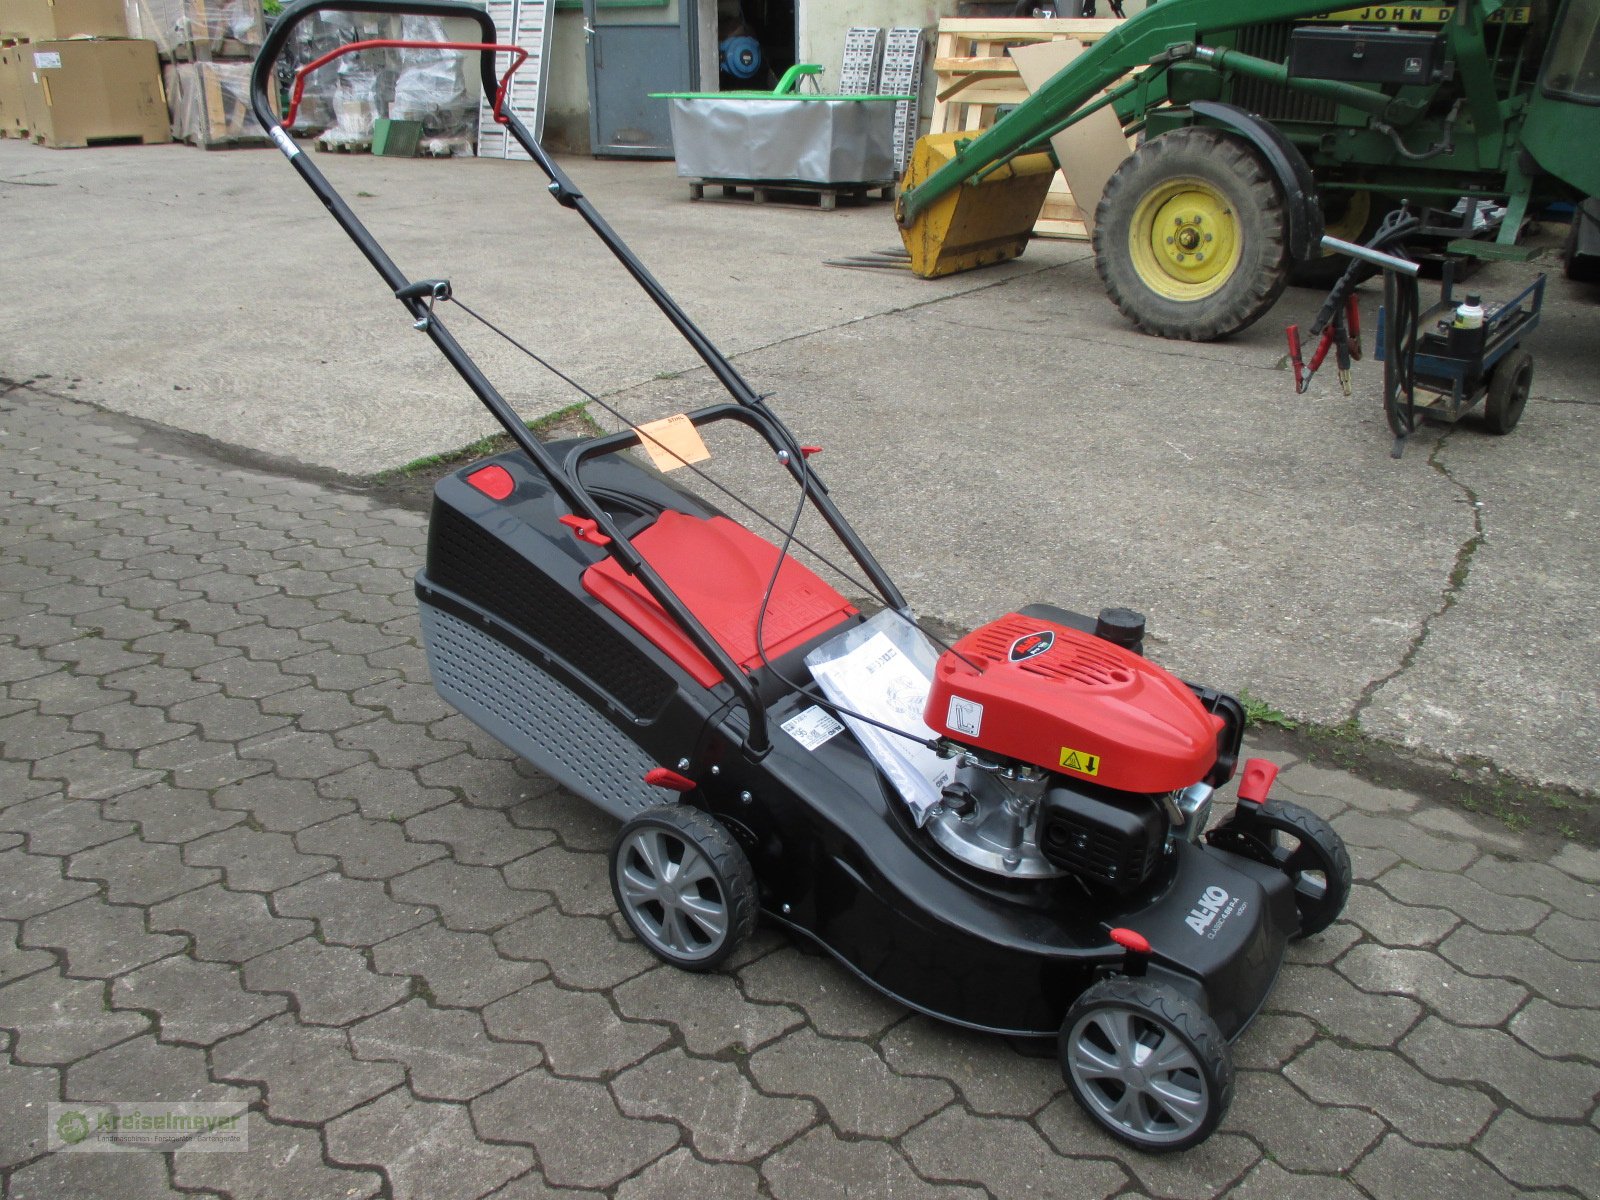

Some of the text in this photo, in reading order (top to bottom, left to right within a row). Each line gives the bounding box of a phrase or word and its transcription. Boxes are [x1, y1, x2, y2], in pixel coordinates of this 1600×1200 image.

[1360, 7, 1525, 20] JOHN DRE
[1184, 886, 1229, 936] AL-KO
